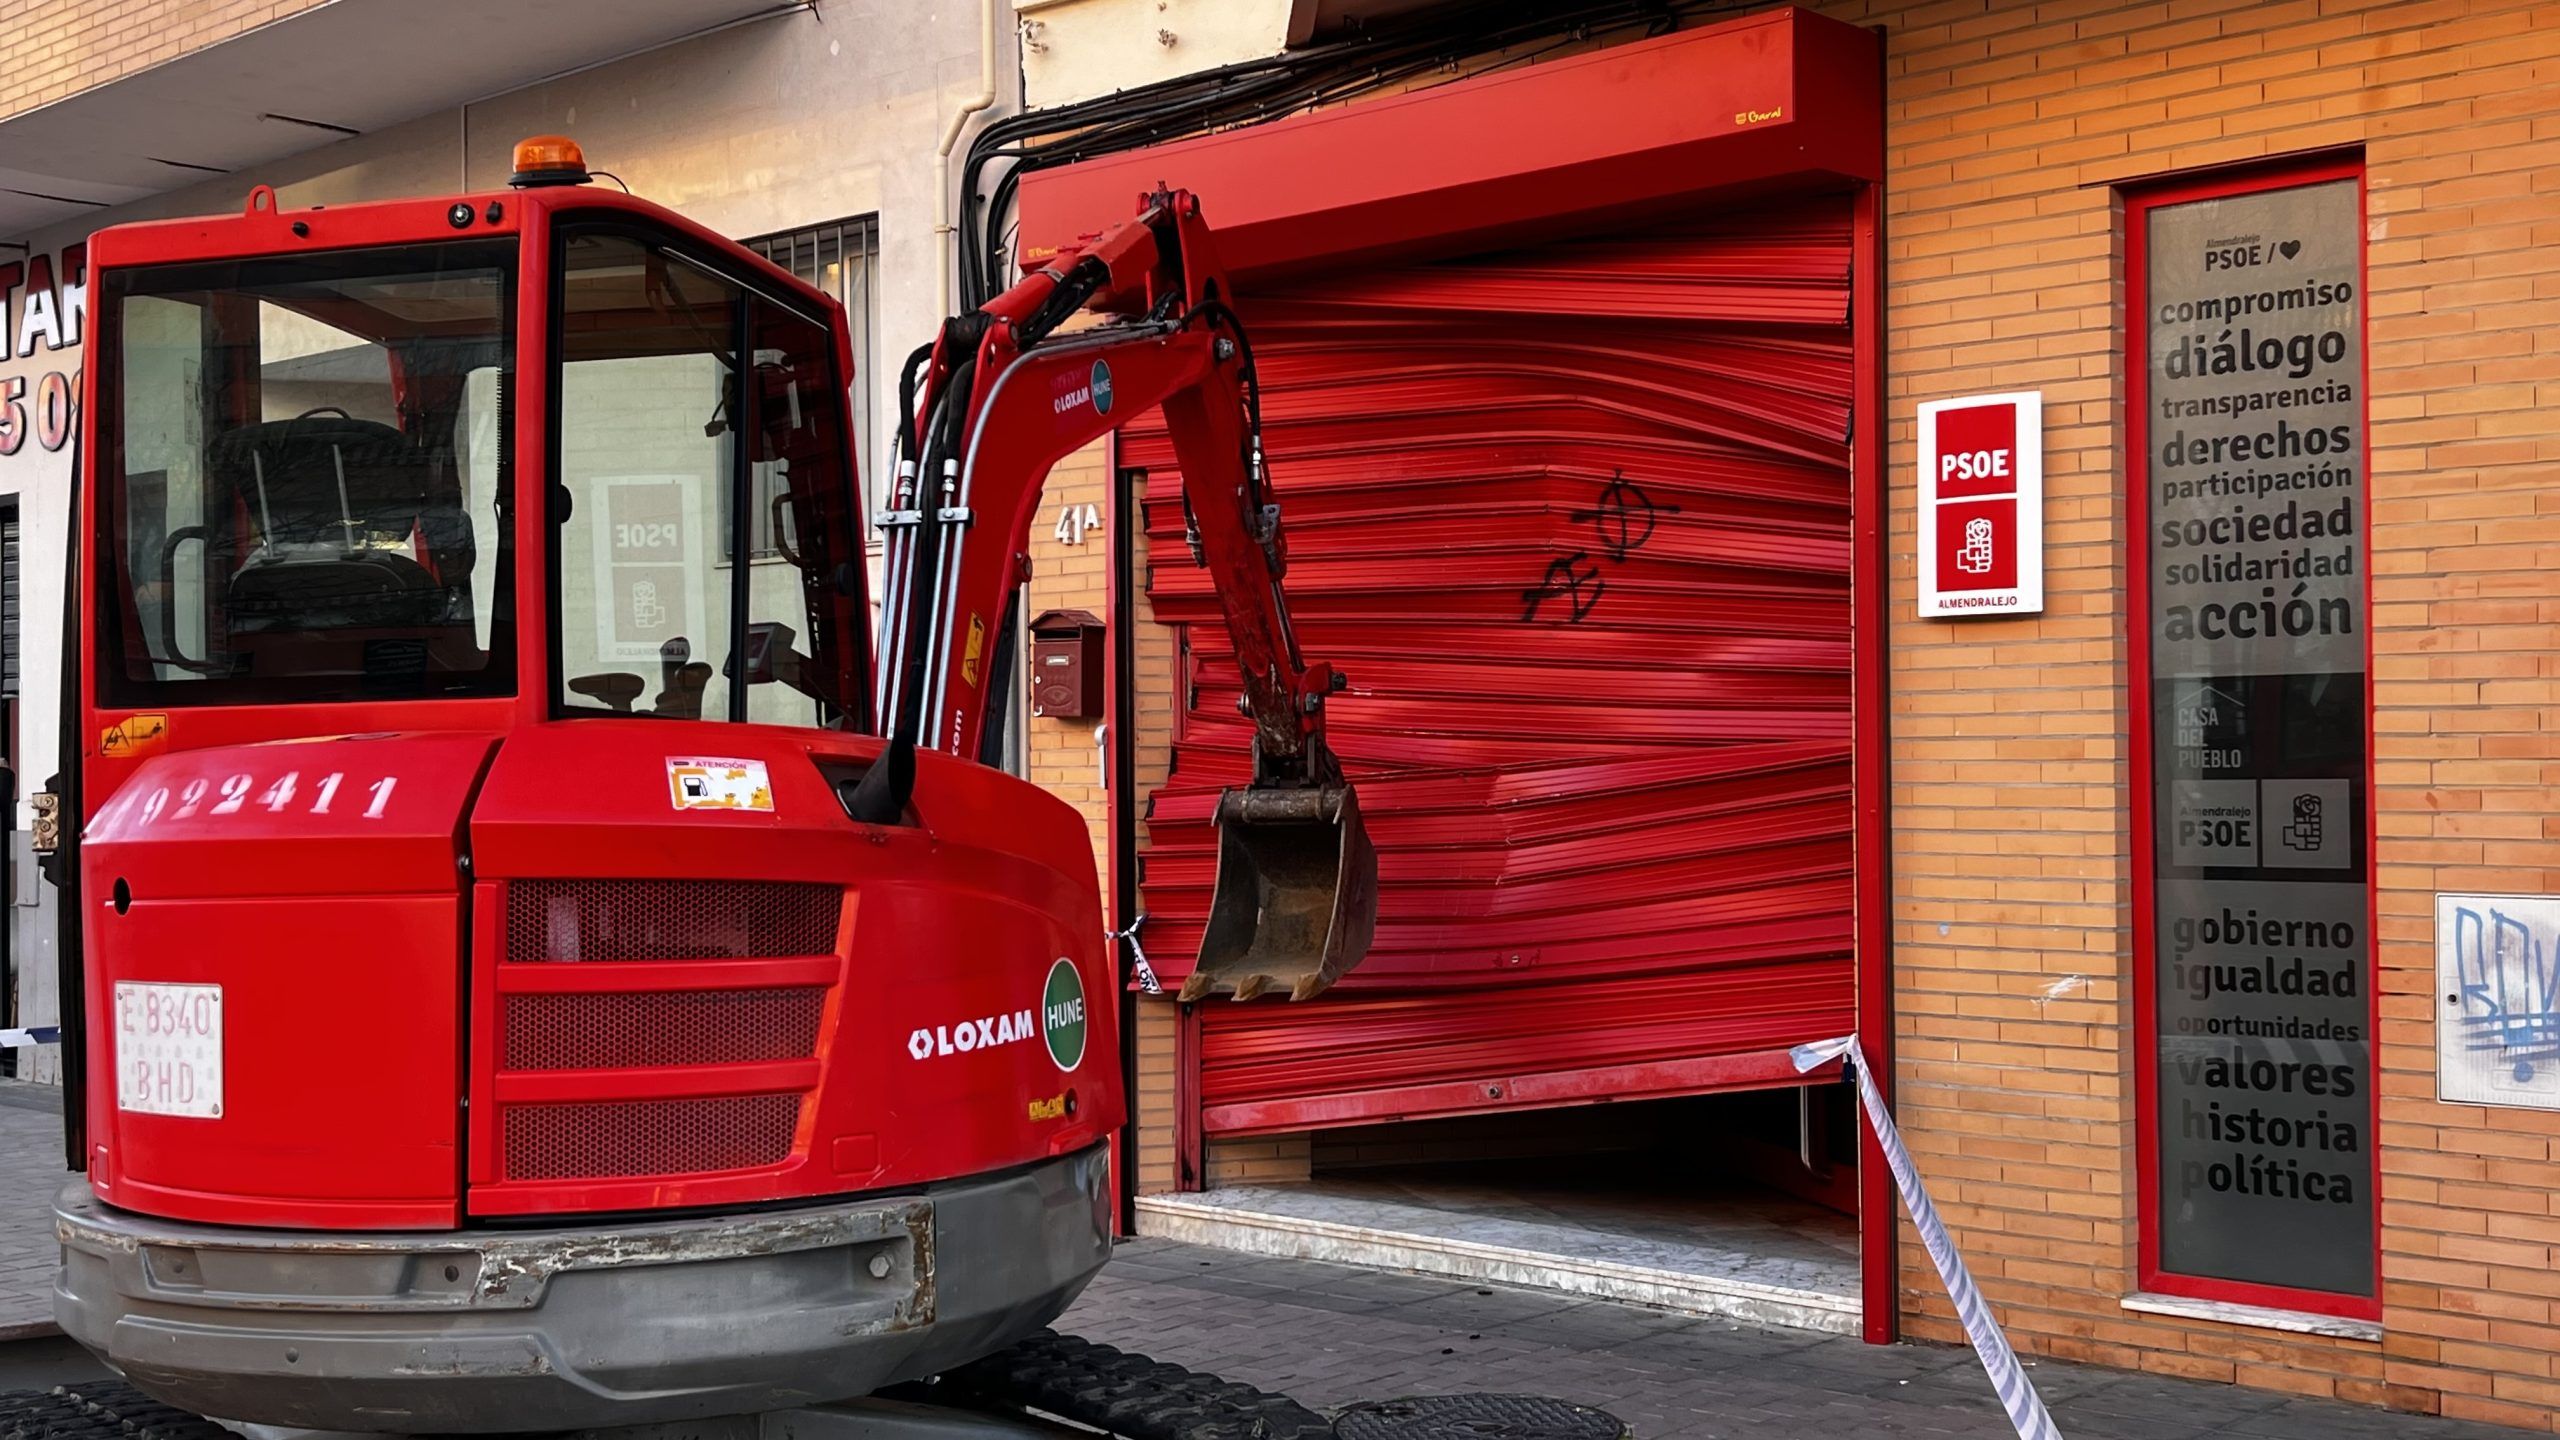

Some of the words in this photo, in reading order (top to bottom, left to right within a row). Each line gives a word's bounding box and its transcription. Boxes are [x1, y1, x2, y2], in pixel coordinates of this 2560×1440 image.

[2206, 234, 2261, 249] Almendralejo
[2206, 245, 2261, 272] PSOE
[2160, 279, 2352, 325] compromiso
[2165, 328, 2346, 380] diálogo
[1061, 386, 1089, 412] LOXAM
[2161, 379, 2351, 419] transparencia
[2162, 420, 2351, 467] derechos
[1941, 449, 2010, 482] PSOE
[2163, 461, 2352, 507] participación
[2161, 496, 2353, 548] sociedad
[2165, 545, 2353, 585] solidaridad
[1938, 596, 2018, 609] ALMENDRALEJO
[2164, 582, 2352, 641] acción
[2178, 707, 2219, 726] CASA
[2178, 729, 2208, 747] DEL
[695, 760, 747, 769] ATENCIÓN
[2178, 750, 2242, 768] PUEBLO
[2180, 806, 2251, 818] Almendralejo
[2179, 820, 2251, 847] PSOE
[2174, 908, 2354, 953] gobierno
[2174, 954, 2356, 1001] igualdad
[146, 991, 210, 1035] 8340
[937, 1009, 1035, 1056] LOXAM
[1048, 998, 1083, 1030] HUNE
[2177, 1015, 2359, 1041] oportunidades
[137, 1060, 194, 1103] BHD
[2176, 1046, 2355, 1097] valores
[2182, 1099, 2357, 1152] historia
[2181, 1153, 2353, 1204] política
